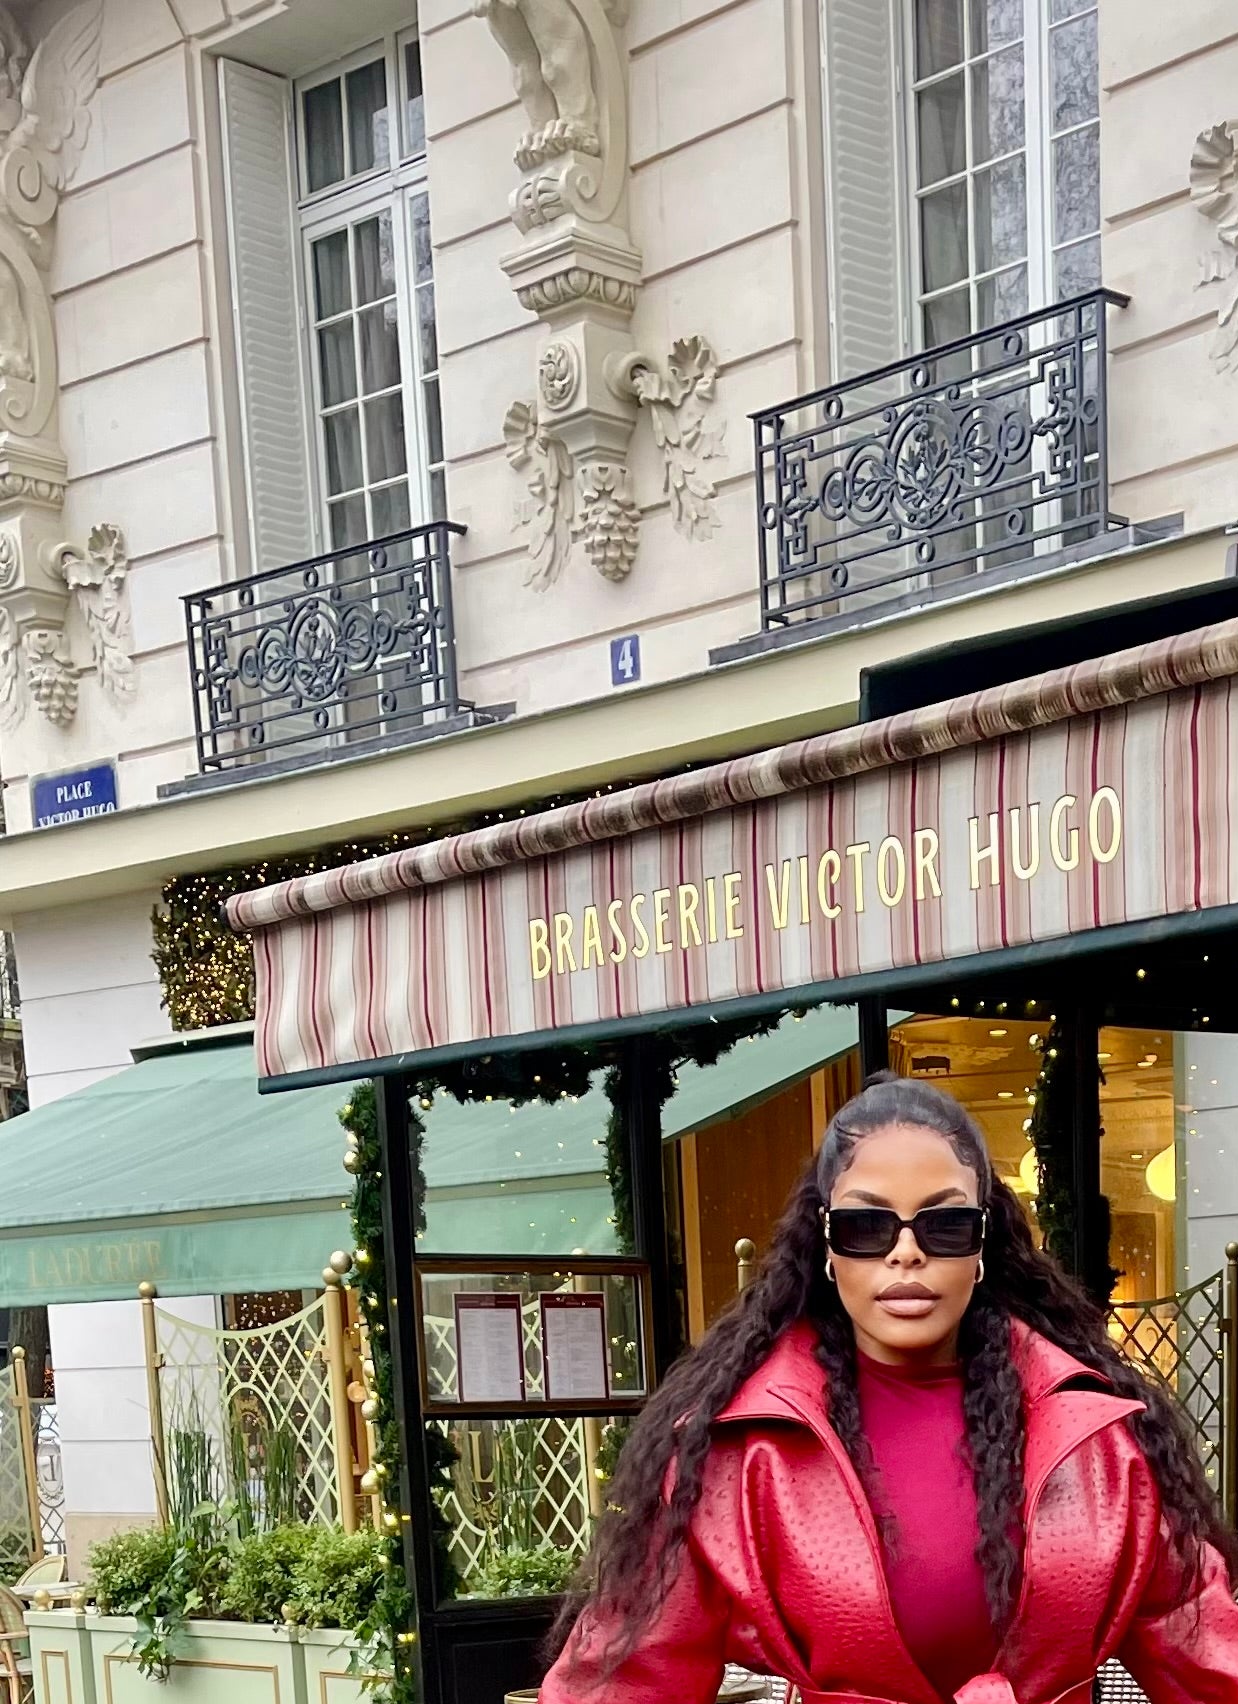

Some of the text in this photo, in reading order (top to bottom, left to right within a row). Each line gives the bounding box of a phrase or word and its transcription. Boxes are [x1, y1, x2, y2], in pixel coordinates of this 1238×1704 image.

[618, 640, 633, 678] 4
[56, 781, 93, 804] PLACE
[529, 785, 1122, 980] BRASSERIE VICTOR HUGO
